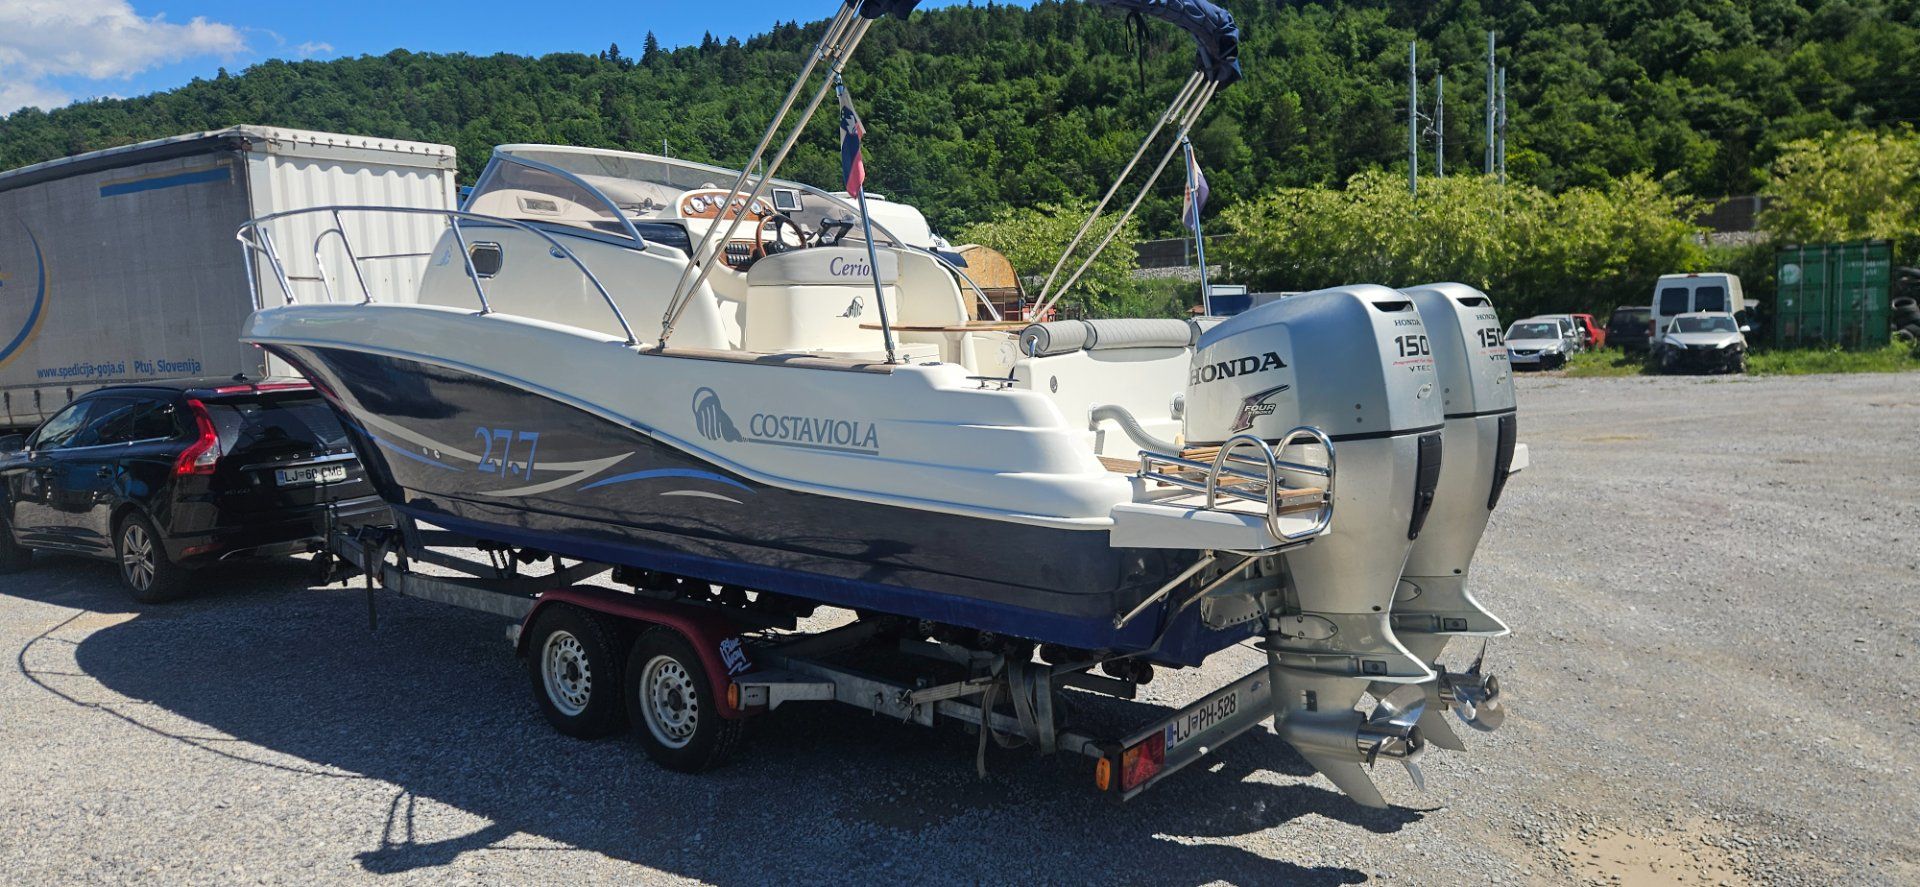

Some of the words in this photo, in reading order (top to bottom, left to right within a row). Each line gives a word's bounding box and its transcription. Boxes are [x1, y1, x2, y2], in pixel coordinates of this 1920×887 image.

[829, 256, 874, 277] Cerio
[1394, 319, 1421, 327] HONDA
[1394, 335, 1430, 358] 150
[1476, 327, 1505, 348] 150
[37, 361, 125, 379] www.spedicija-goja.si
[134, 360, 155, 375] Ptuj,
[157, 358, 201, 375] Slovenija
[1189, 351, 1288, 387] HONDA
[1408, 365, 1432, 373] VTEC
[750, 412, 879, 448] COSTAVIOLA
[275, 449, 347, 460] VOLVO
[474, 426, 540, 481] 27.7
[284, 471, 299, 482] LJ
[1176, 715, 1191, 742] LJ
[1199, 693, 1236, 730] PH-528
